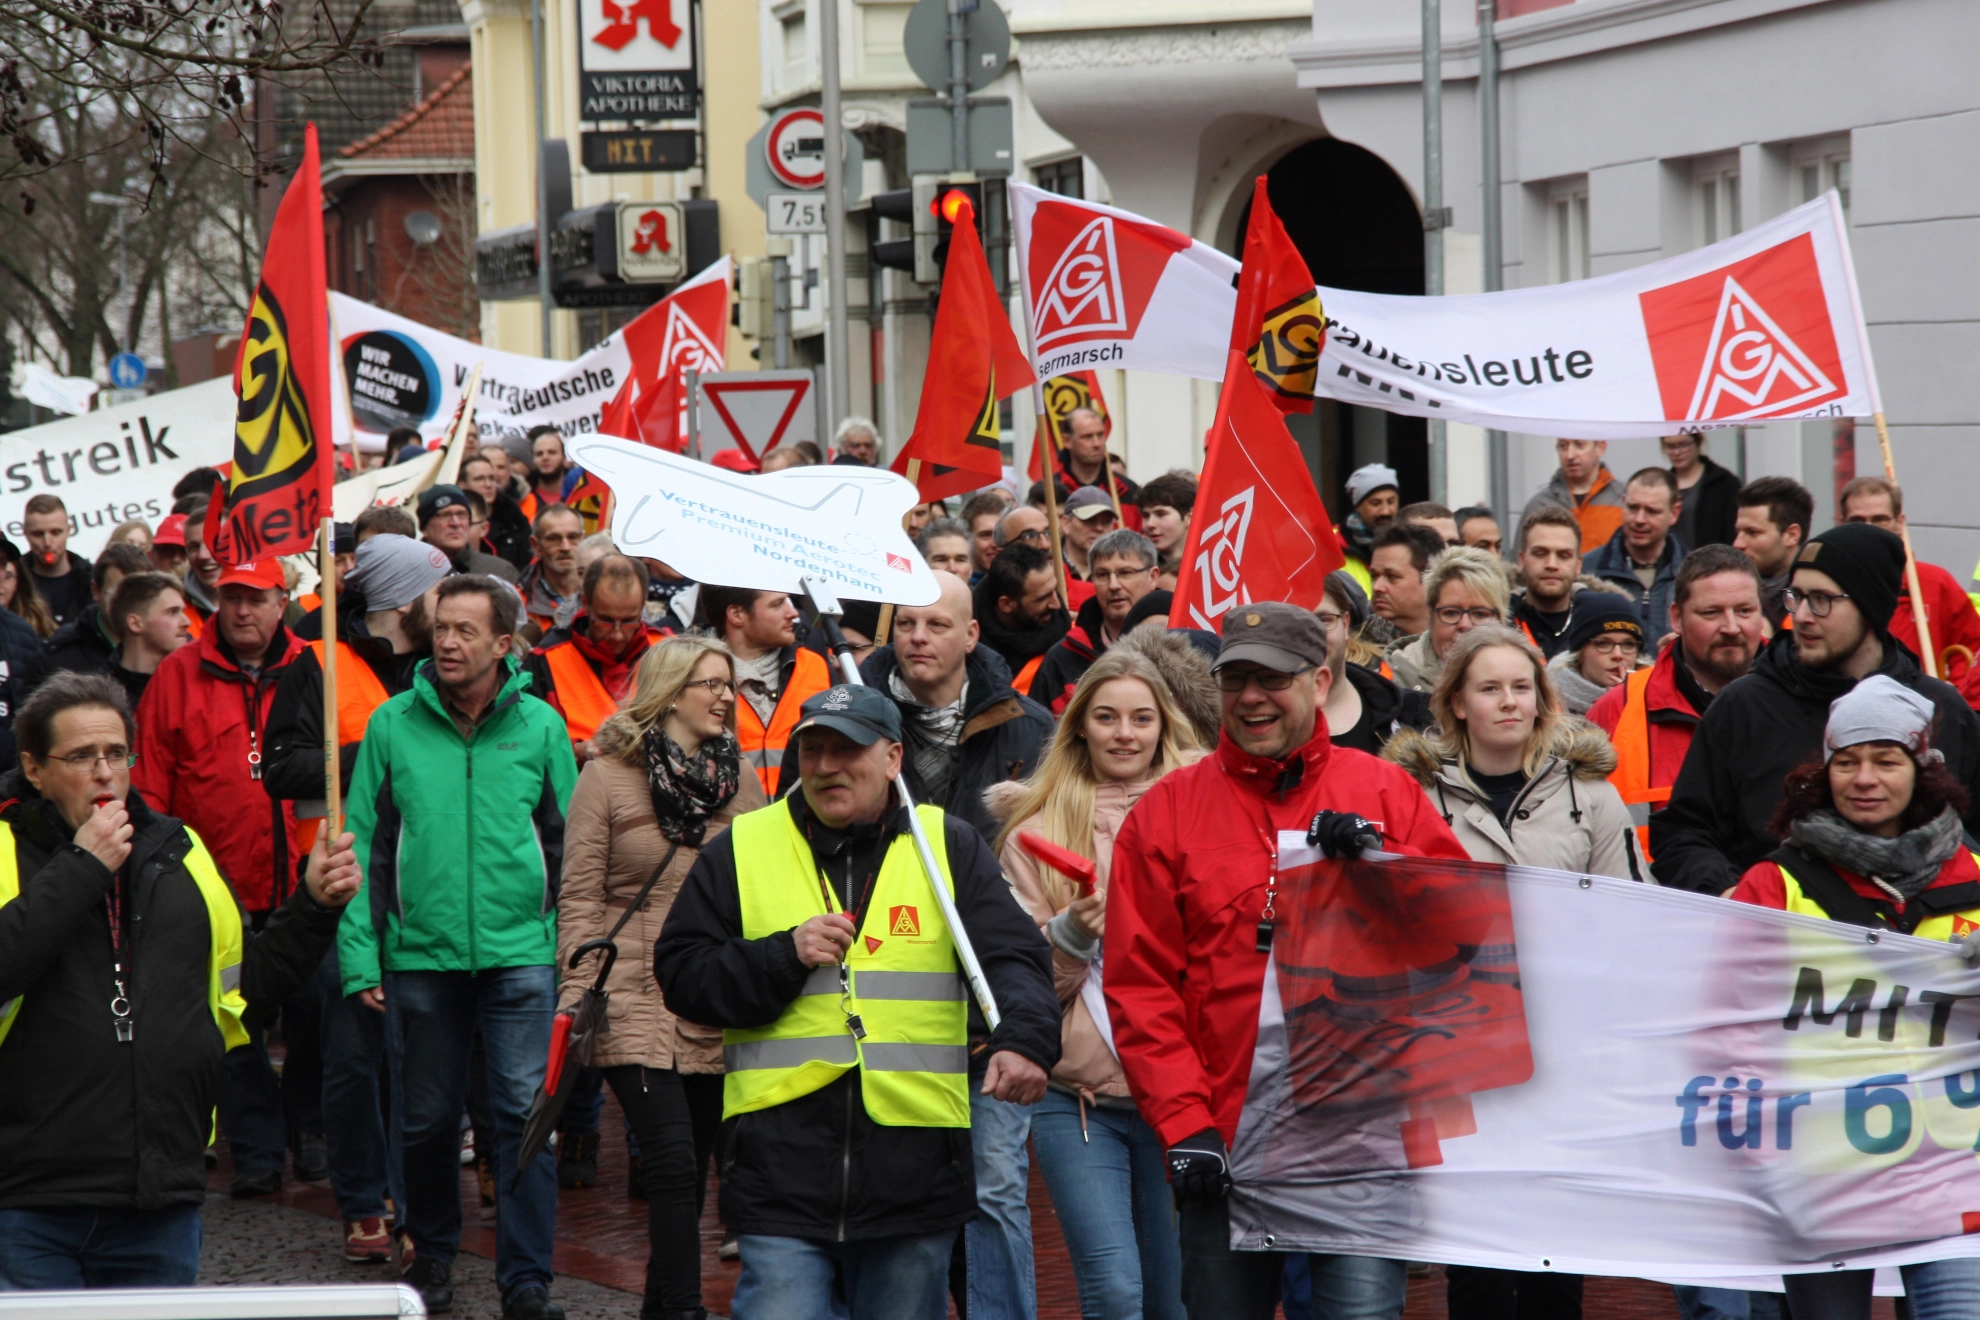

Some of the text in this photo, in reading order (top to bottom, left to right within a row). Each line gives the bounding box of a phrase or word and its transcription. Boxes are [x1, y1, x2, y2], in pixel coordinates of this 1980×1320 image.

[584, 94, 694, 113] APOTHEKE
[591, 76, 685, 93] VIKTORIA
[356, 360, 420, 393] MACHEN
[361, 344, 391, 367] WIR
[1039, 343, 1123, 378] sermarsch
[354, 376, 400, 405] MEHR.
[0, 416, 181, 495] streik
[231, 487, 320, 564] Meta
[658, 488, 839, 554] Vertrauensleute
[680, 508, 790, 551] Premium
[790, 543, 882, 582] Aerotec
[752, 543, 883, 595] Nordenham
[1782, 966, 1980, 1048] MIT
[1675, 1074, 1812, 1151] für
